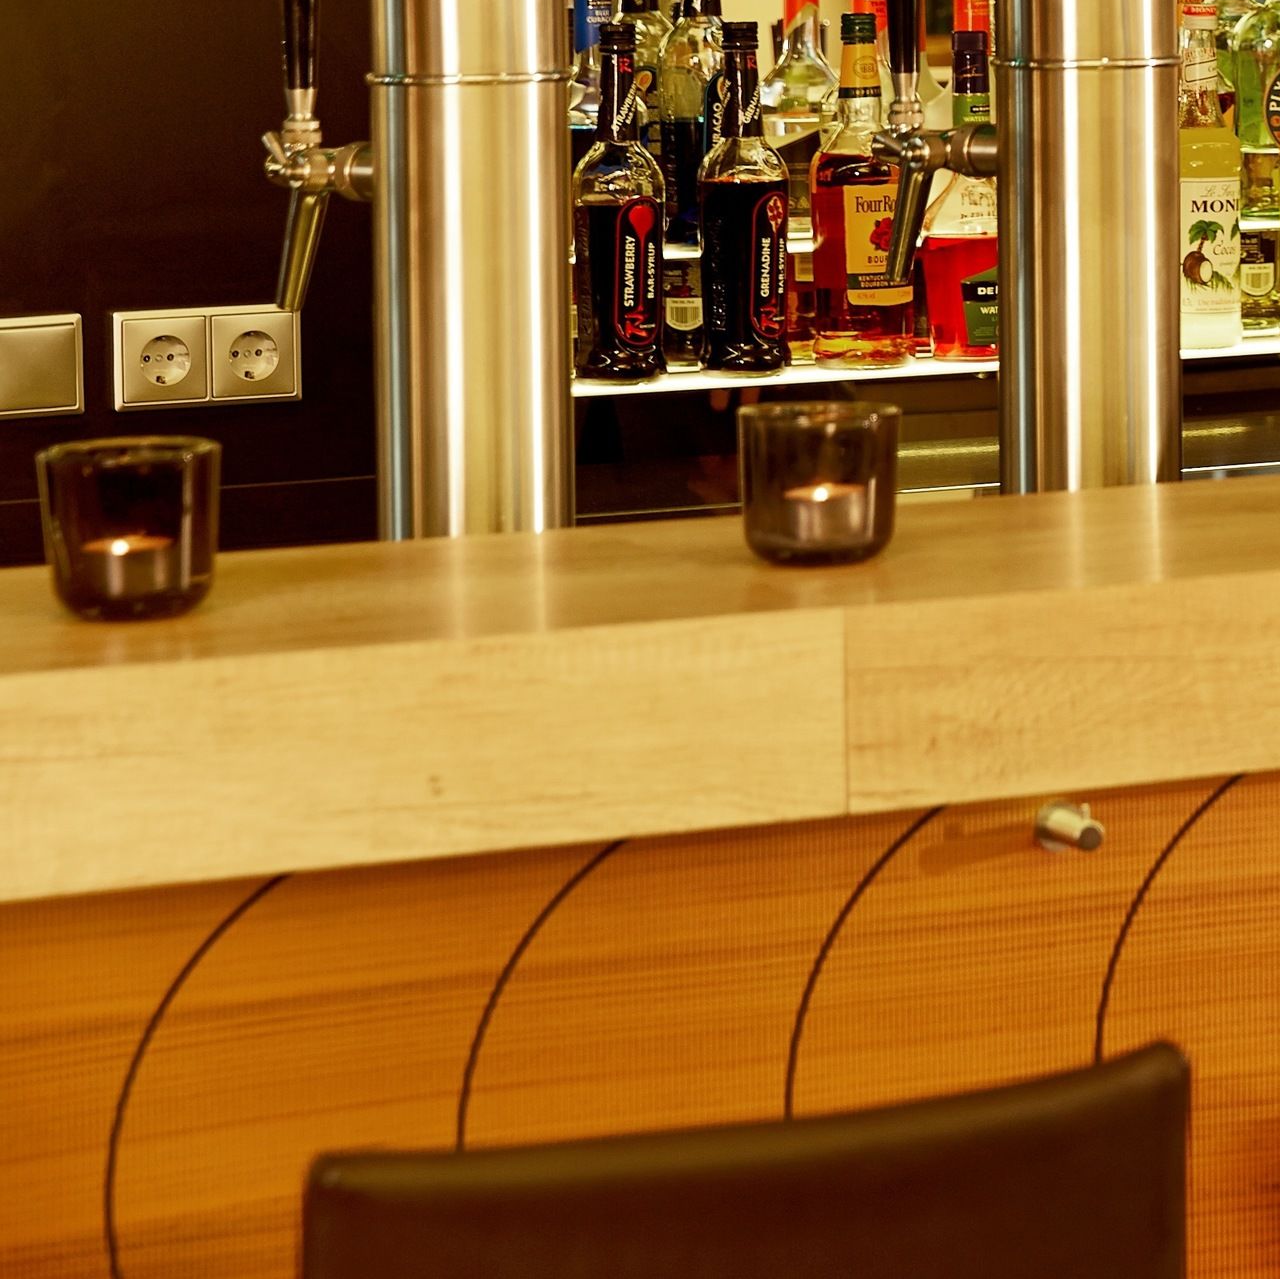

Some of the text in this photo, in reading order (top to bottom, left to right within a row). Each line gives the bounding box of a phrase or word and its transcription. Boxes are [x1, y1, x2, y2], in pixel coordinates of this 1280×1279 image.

[855, 195, 882, 213] Four
[624, 235, 636, 308] STRAWBERRY
[647, 242, 656, 299] BAR-SYRUP
[760, 237, 771, 298] GRENADINE
